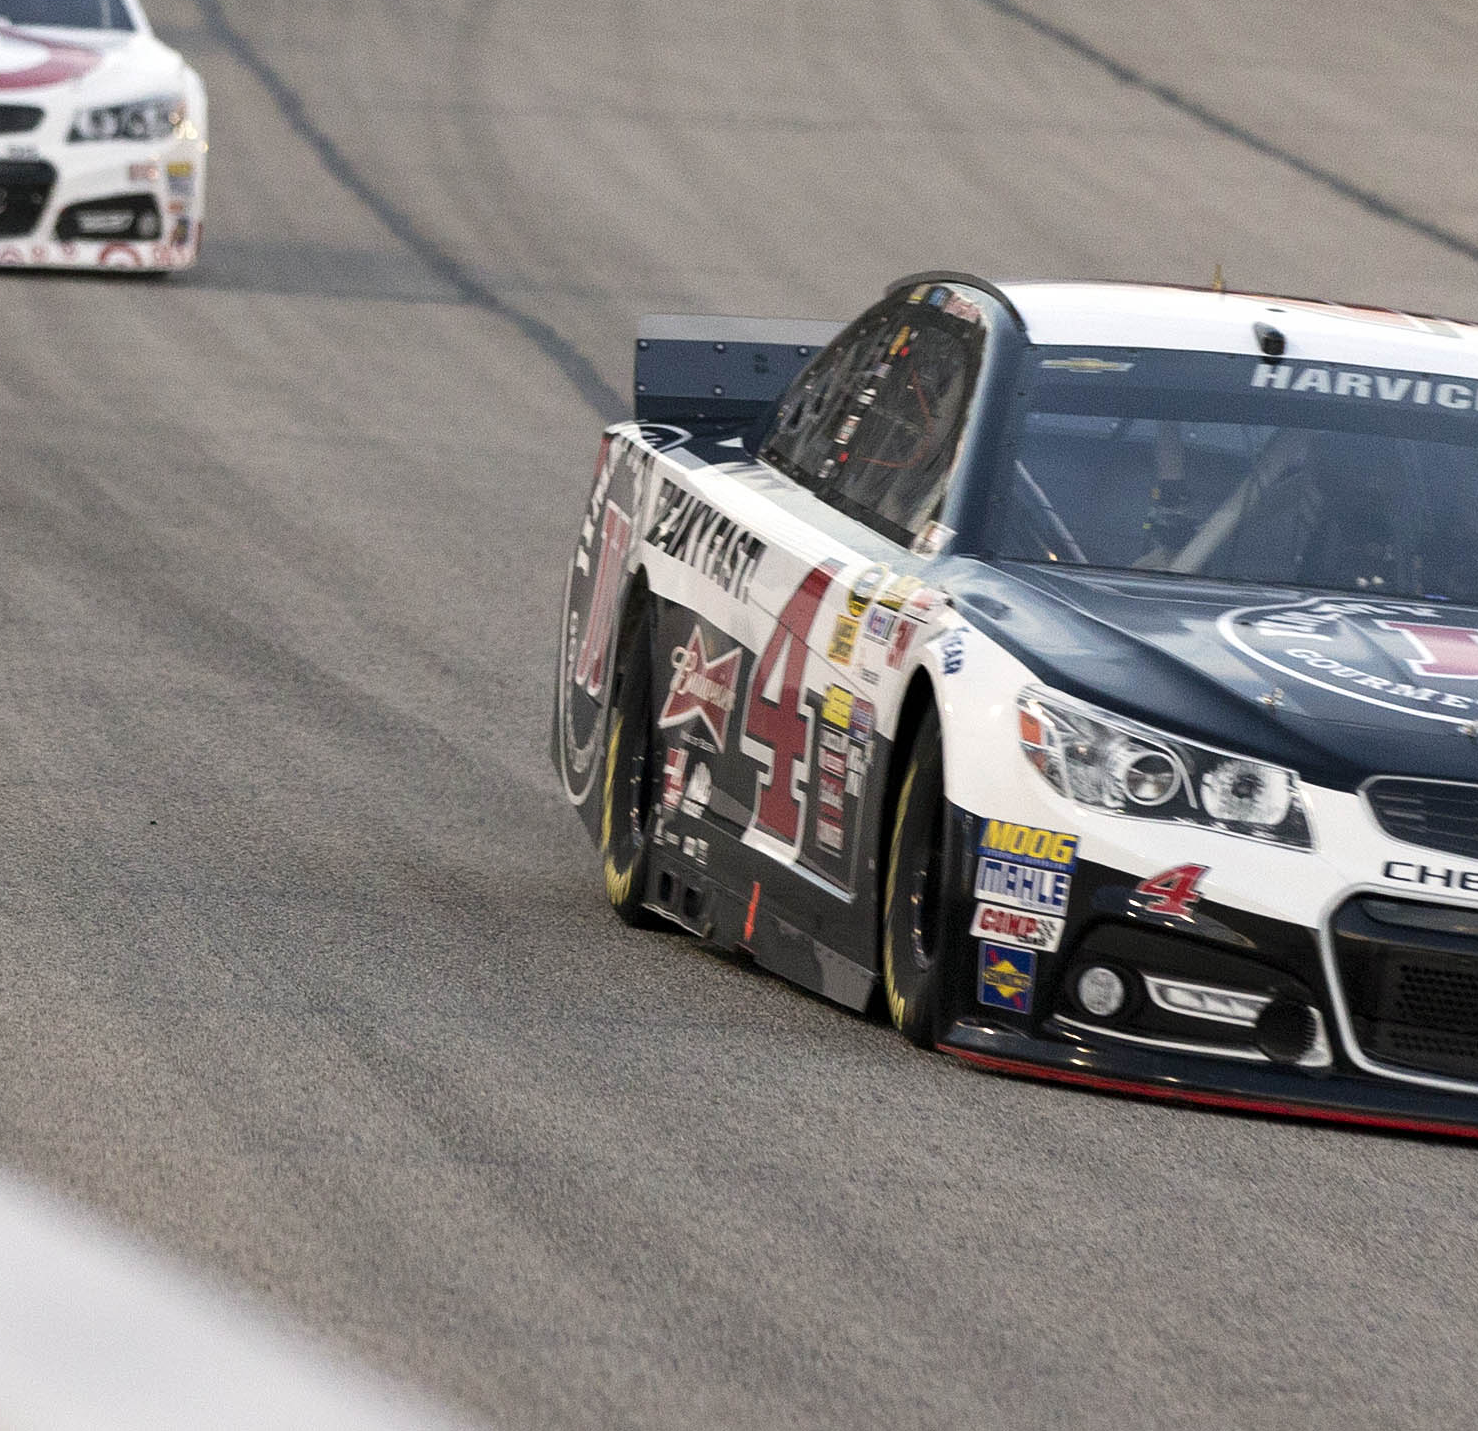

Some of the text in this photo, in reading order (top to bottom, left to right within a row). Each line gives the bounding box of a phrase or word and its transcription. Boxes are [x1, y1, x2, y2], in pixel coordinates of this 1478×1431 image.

[739, 557, 849, 865] 4
[980, 820, 1080, 865] MOOG
[1135, 862, 1213, 918] 4
